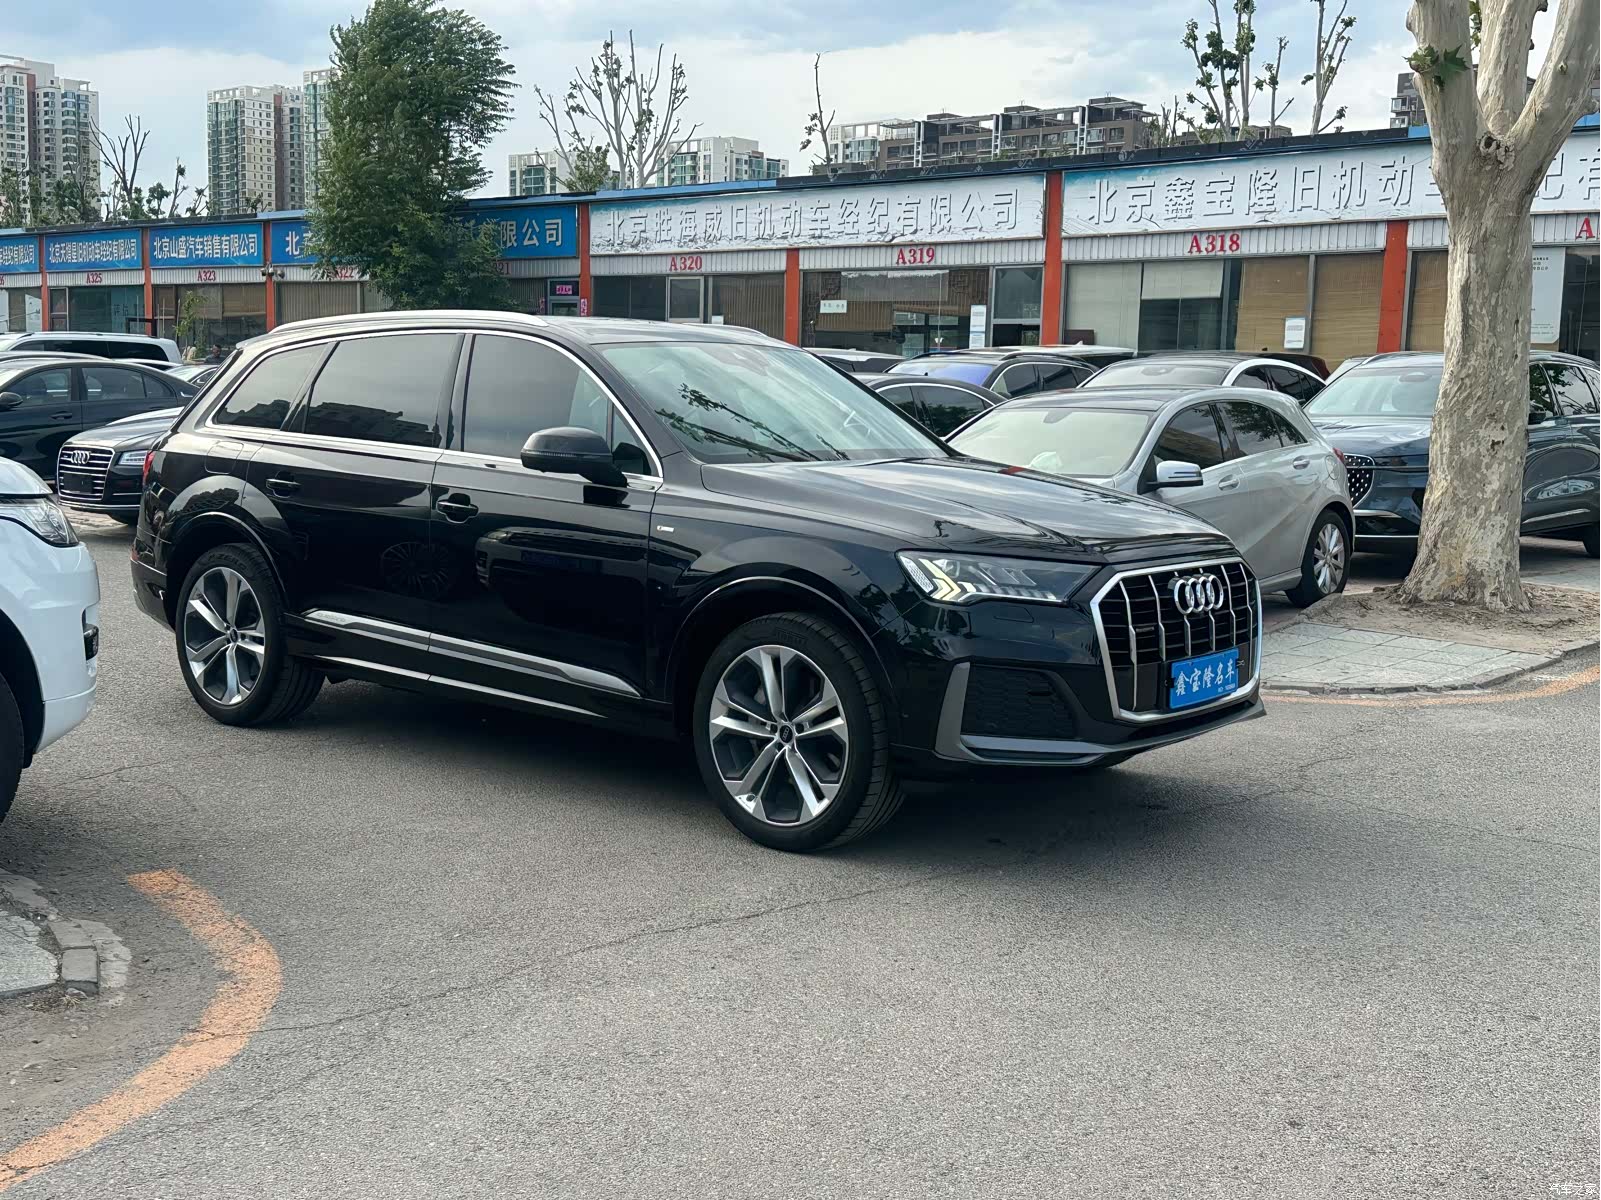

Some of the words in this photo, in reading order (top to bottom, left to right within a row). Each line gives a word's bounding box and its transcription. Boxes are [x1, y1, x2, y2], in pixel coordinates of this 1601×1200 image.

[605, 188, 1019, 244] 北京胜海威旧机动车经纪有限公司
[153, 233, 258, 259] 北京山盛汽车销售有限公司
[1187, 233, 1240, 255] A318
[668, 255, 703, 272] A320
[895, 247, 935, 265] A319
[86, 272, 103, 284] A325
[197, 270, 216, 282] A323
[1176, 658, 1235, 697] 鑫宝隆名车
